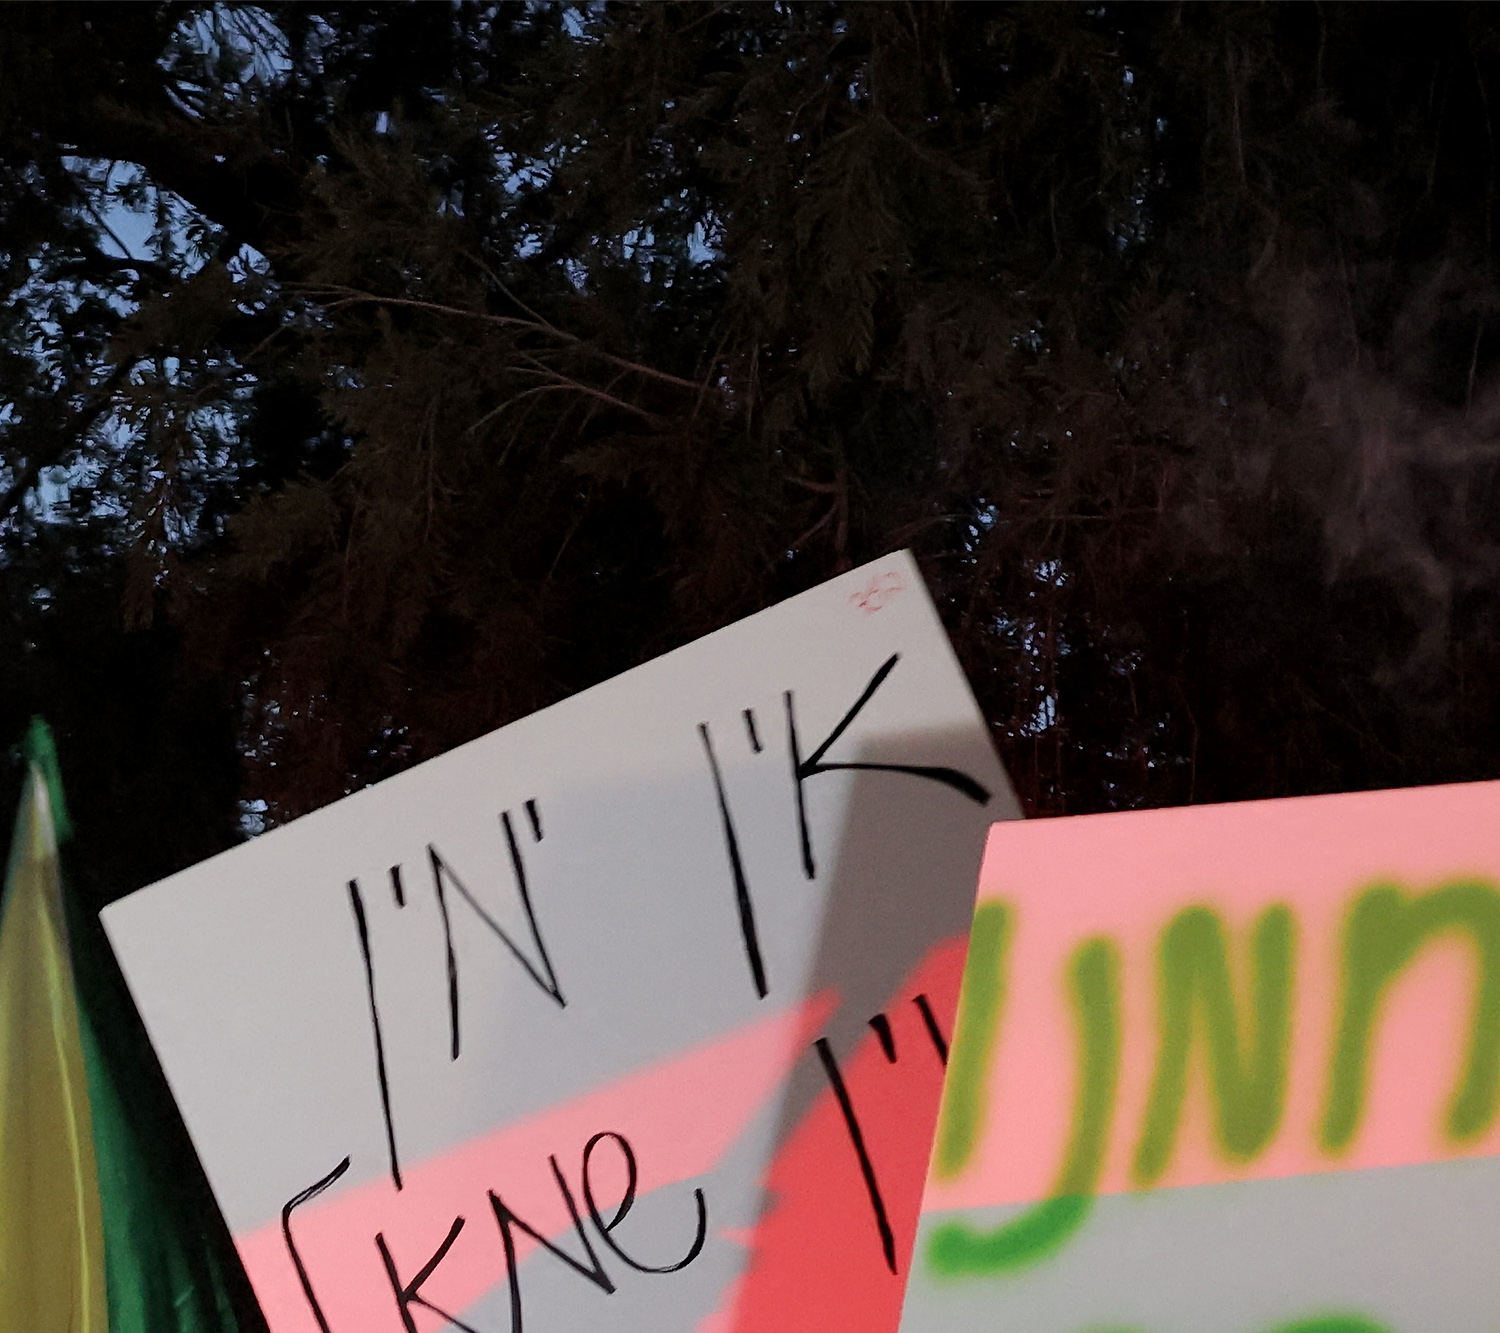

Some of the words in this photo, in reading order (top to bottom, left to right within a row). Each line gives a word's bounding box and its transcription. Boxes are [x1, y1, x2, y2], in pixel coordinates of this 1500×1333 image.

[346, 797, 567, 1192] ימין
[697, 652, 991, 1000] אין
[813, 993, 949, 1276] ין
